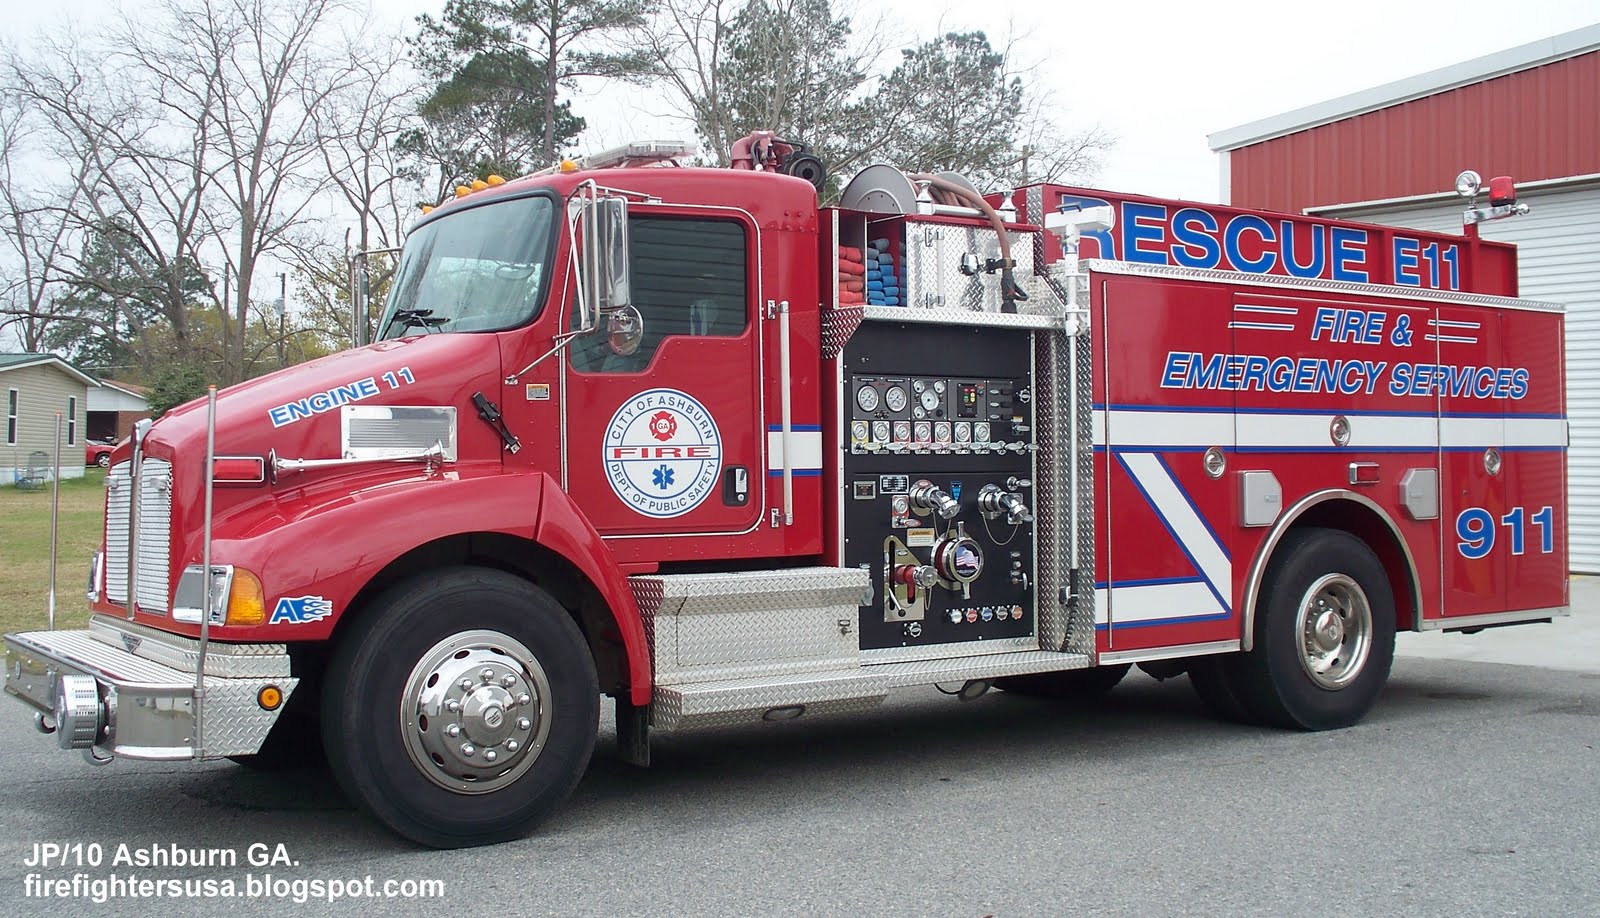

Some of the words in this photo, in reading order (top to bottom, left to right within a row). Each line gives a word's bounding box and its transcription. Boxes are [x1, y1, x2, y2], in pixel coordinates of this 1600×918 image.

[1061, 194, 1369, 283] RESCUE
[1393, 236, 1460, 291] E11
[1311, 307, 1387, 344] FIRE
[1390, 314, 1414, 347] &
[268, 377, 380, 428] ENGINE
[382, 366, 415, 389] 11
[1160, 351, 1387, 395] EMERGENCY
[1388, 361, 1529, 400] SERVICES
[611, 408, 634, 440] CITY
[636, 397, 653, 411] OF
[658, 396, 714, 440] ASHBURN
[658, 422, 668, 430] GA
[614, 447, 711, 458] FIRE
[611, 464, 631, 496] DEPT.
[633, 493, 647, 506] OF
[649, 497, 687, 511] PUBLIC
[688, 461, 715, 501] SAFETY
[1456, 506, 1553, 559] 911
